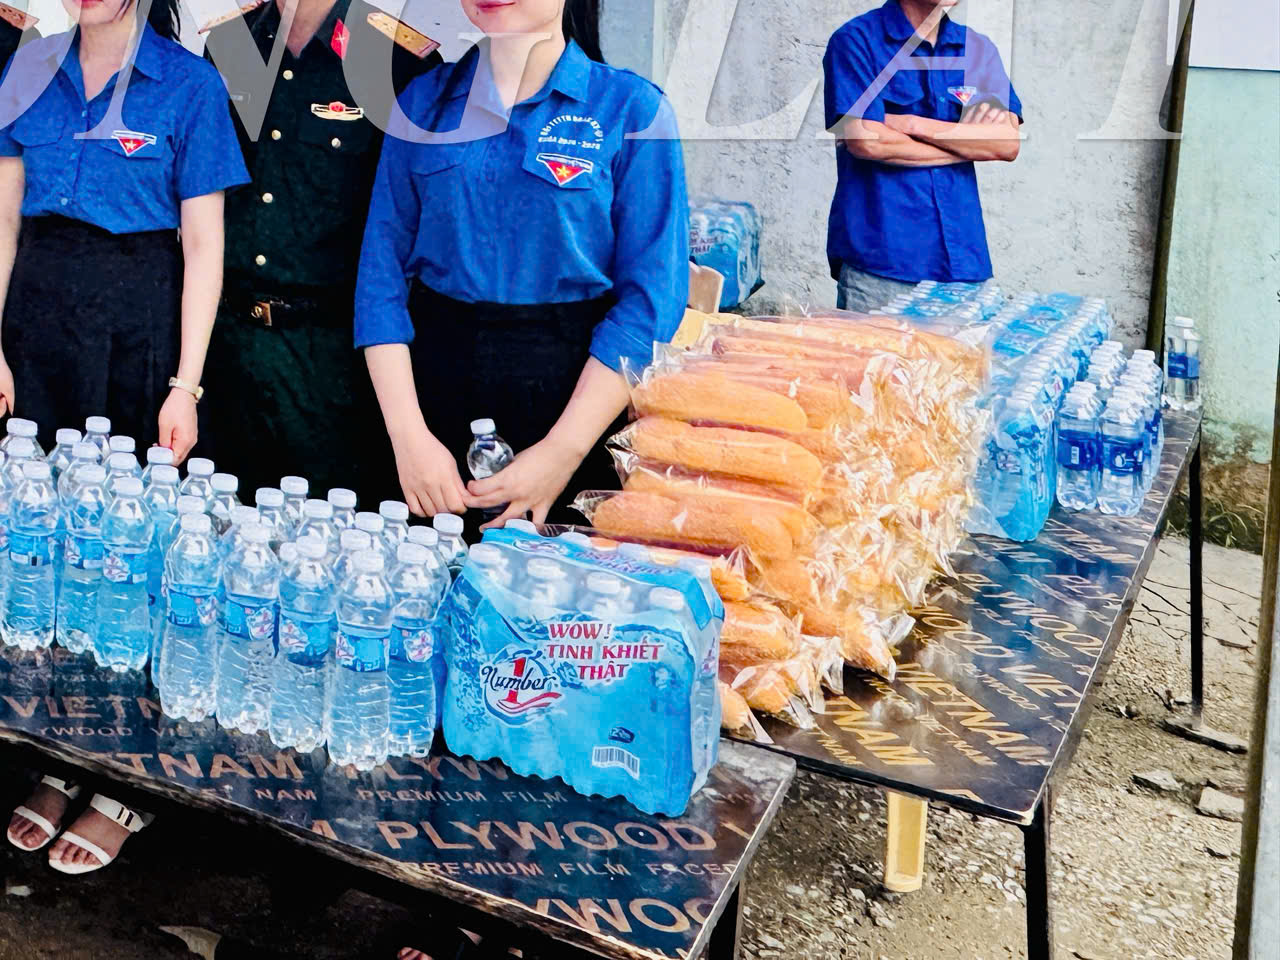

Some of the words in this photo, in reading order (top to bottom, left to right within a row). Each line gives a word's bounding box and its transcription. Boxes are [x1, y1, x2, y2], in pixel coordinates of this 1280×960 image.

[549, 623, 613, 640] WOW!
[547, 644, 593, 660] TINH
[602, 635, 663, 661] KHIẾT
[481, 665, 557, 691] Number
[578, 660, 629, 683] THẬT
[2, 694, 164, 721] VIETN
[39, 726, 134, 737] YWOOD
[820, 695, 936, 765] TNAM
[114, 752, 305, 780] TNAM
[254, 788, 317, 801] NAM
[500, 790, 568, 803] FILM
[376, 820, 718, 852] PLYWOOD
[559, 861, 632, 877] FILM
